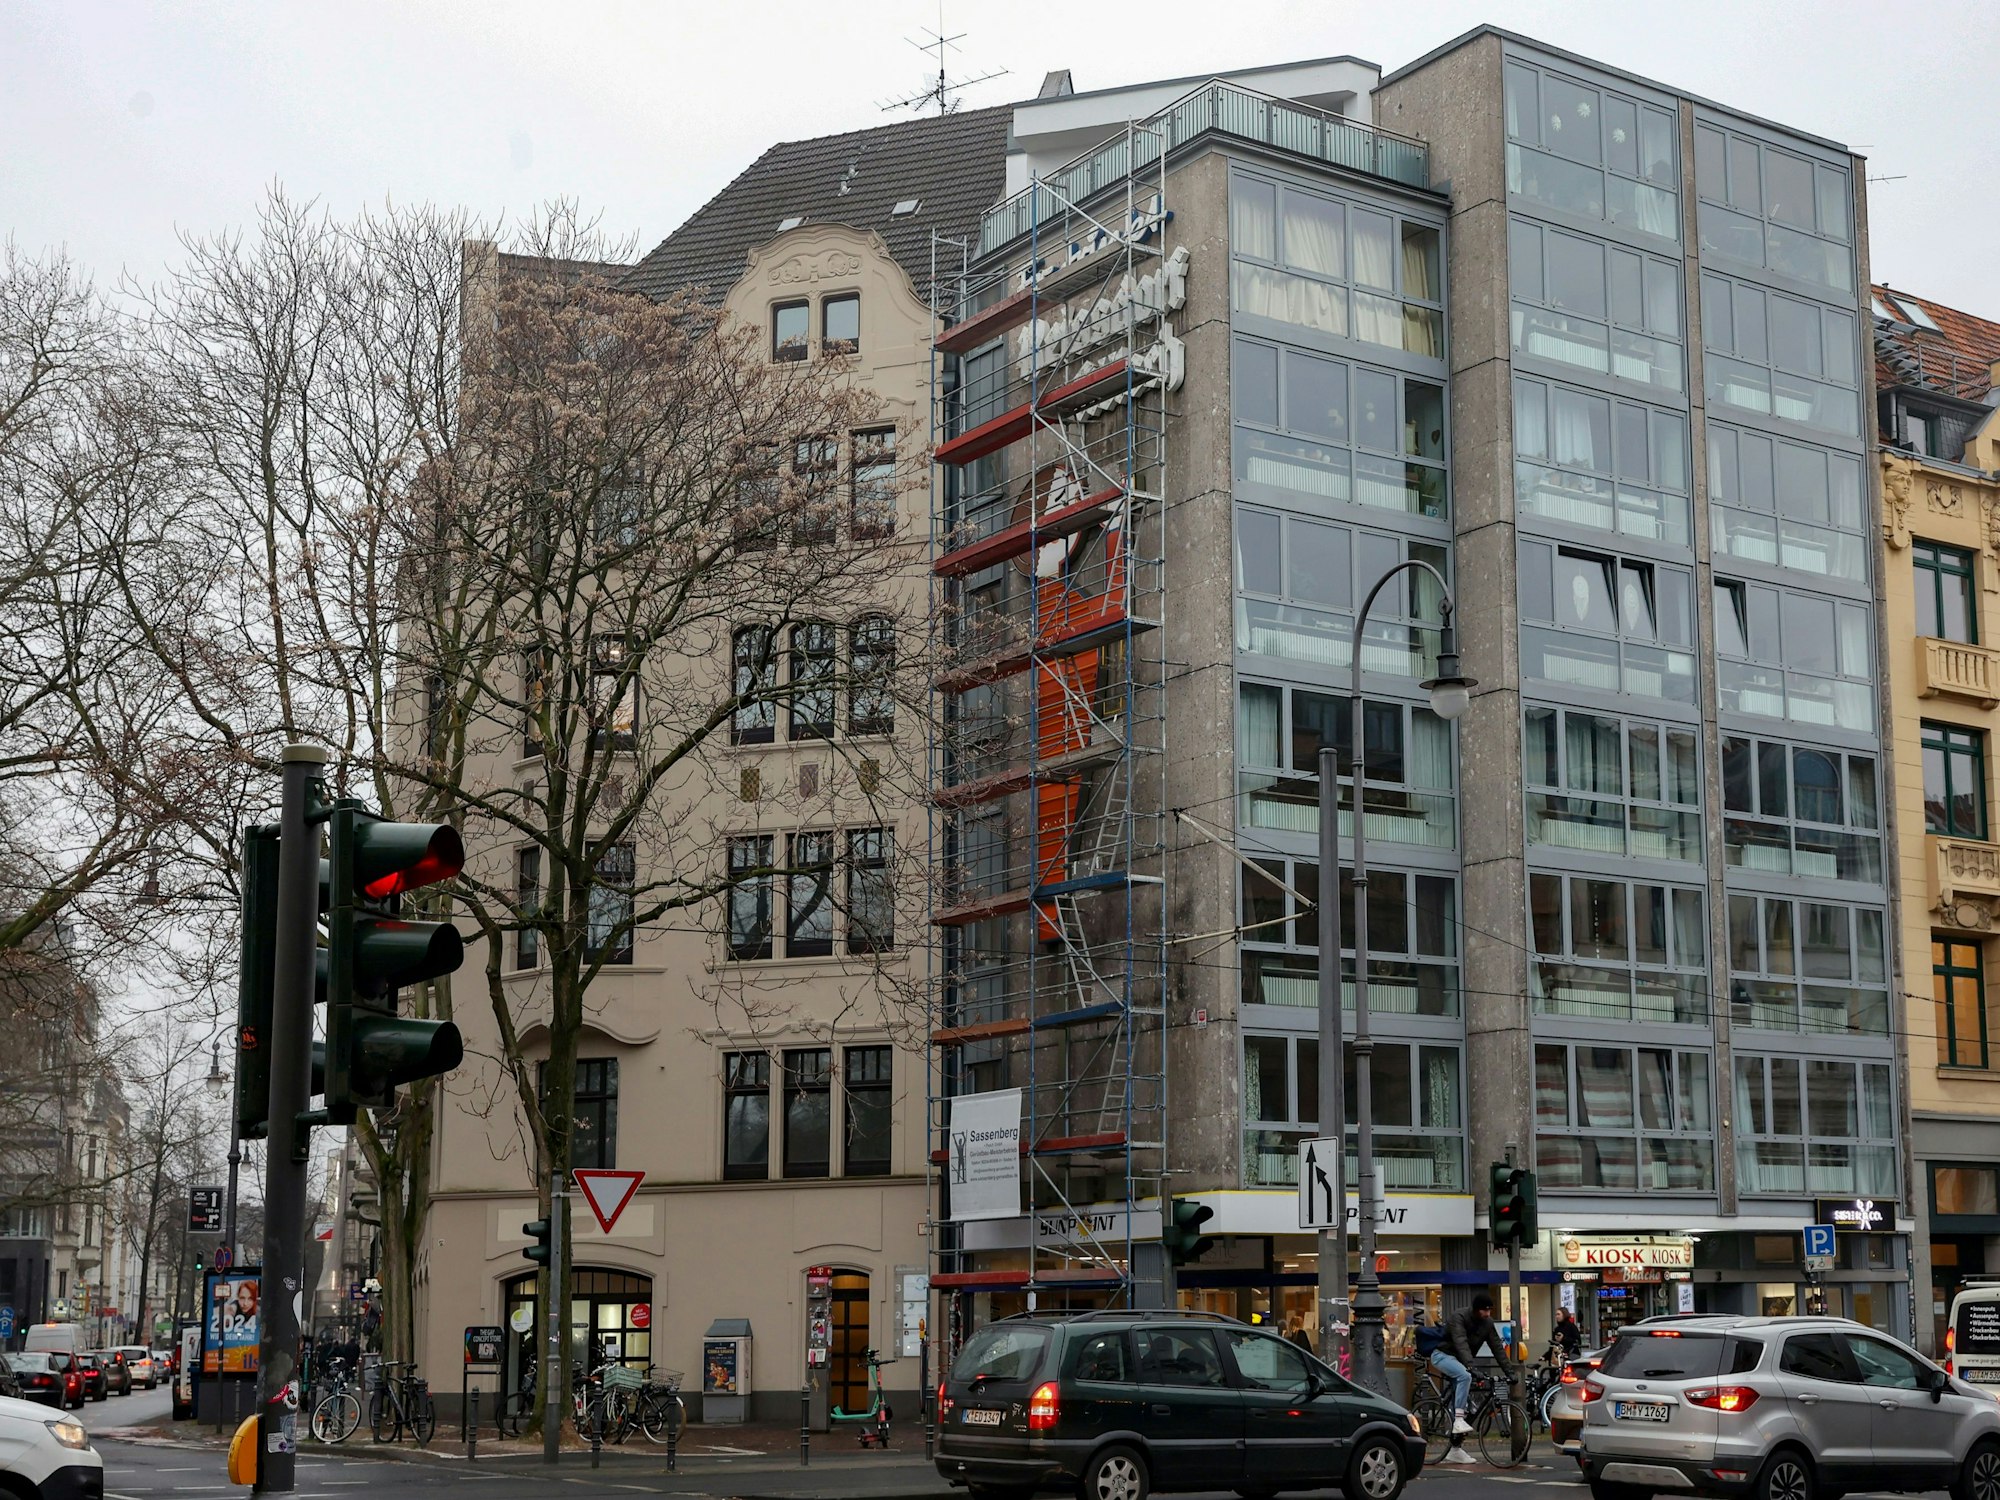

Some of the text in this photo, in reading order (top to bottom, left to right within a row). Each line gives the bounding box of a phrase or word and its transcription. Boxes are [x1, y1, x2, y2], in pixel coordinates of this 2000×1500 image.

[970, 1127, 1018, 1142] Sassenberg
[1811, 1230, 1828, 1254] P
[1586, 1248, 1682, 1264] KIOSK KIOSK
[210, 1314, 256, 1333] 2024
[1620, 1404, 1666, 1418] BM Y 1762
